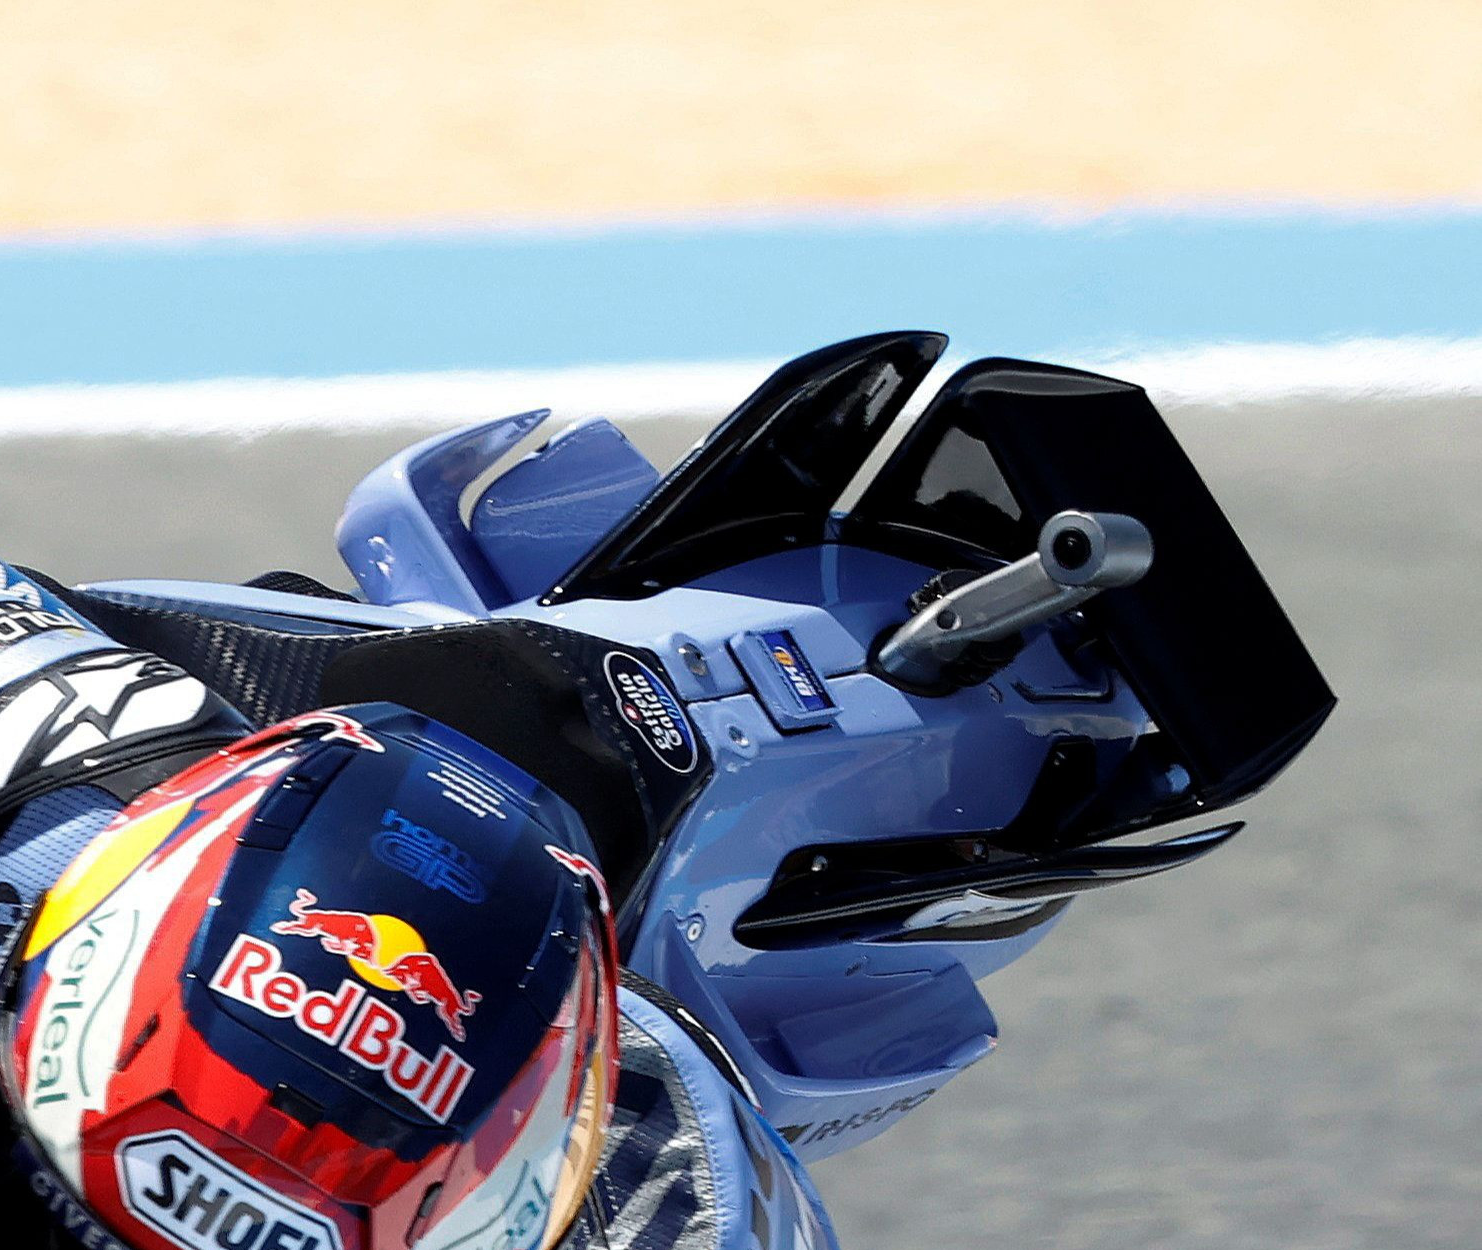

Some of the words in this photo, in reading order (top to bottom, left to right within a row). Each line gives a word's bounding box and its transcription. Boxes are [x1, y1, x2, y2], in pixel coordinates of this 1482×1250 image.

[617, 673, 674, 751] Estrella
[632, 674, 683, 747] Galicia
[34, 908, 119, 1106] verleal
[212, 935, 356, 1047] Red
[334, 998, 474, 1124] Bull
